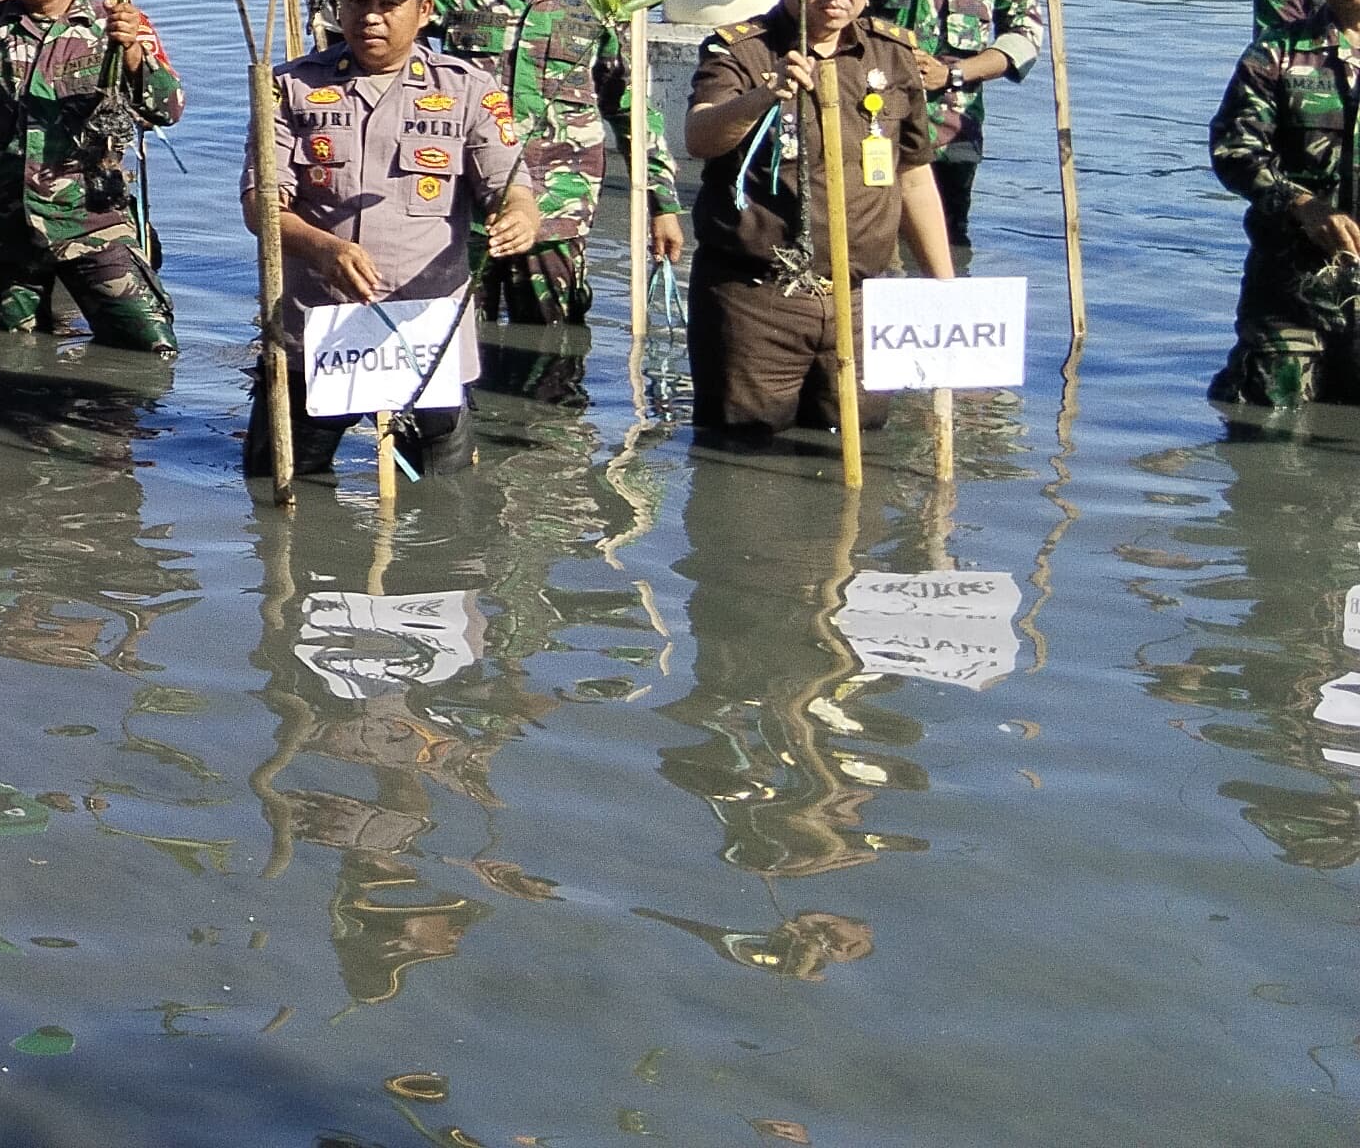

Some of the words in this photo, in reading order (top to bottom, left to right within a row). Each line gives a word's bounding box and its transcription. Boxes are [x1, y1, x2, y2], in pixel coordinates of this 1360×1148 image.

[404, 119, 462, 138] POLRI
[870, 322, 1007, 350] KAJARI
[313, 344, 440, 377] KAPOLRES
